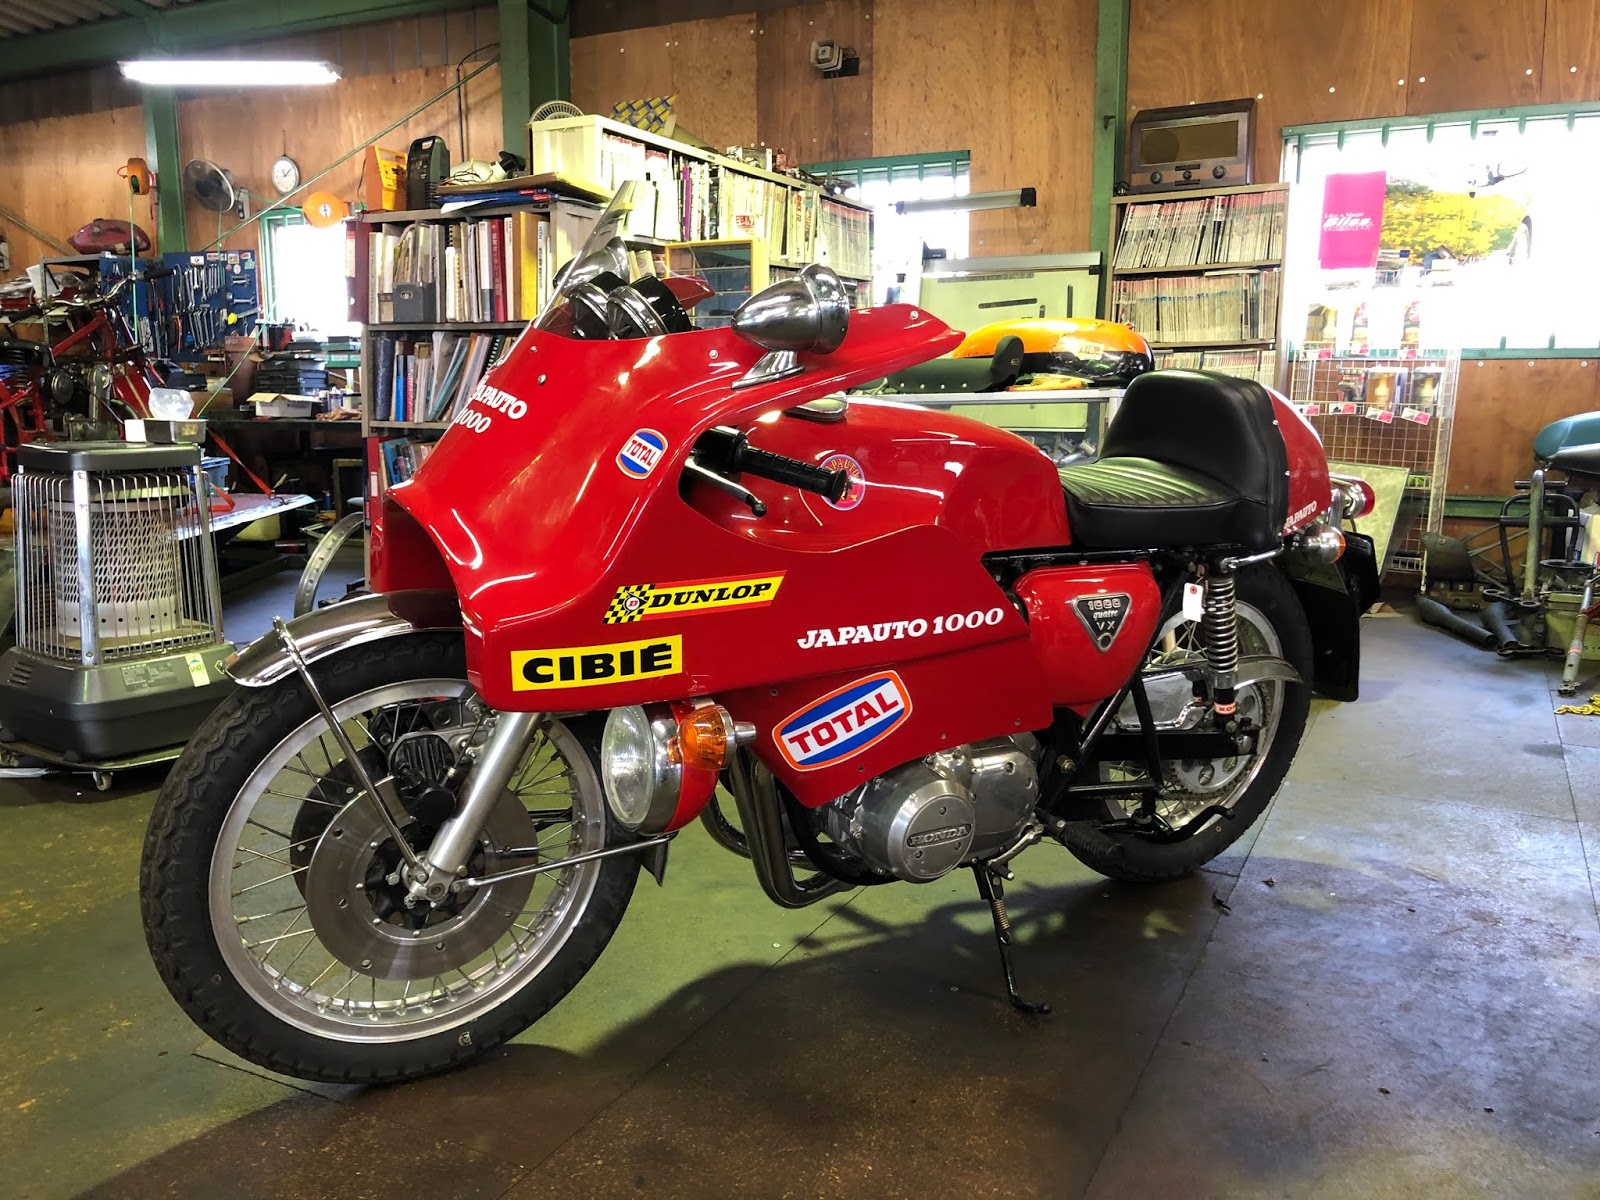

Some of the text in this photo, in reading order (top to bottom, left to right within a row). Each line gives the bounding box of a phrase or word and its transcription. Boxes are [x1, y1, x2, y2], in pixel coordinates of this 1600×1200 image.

[626, 439, 656, 466] TOTAL
[648, 583, 772, 608] DUNLOP
[797, 607, 1004, 649] JAPAUTO 1000
[1093, 610, 1119, 621] quatre
[788, 692, 899, 754] TOTAL
[909, 826, 969, 845] HONDA
